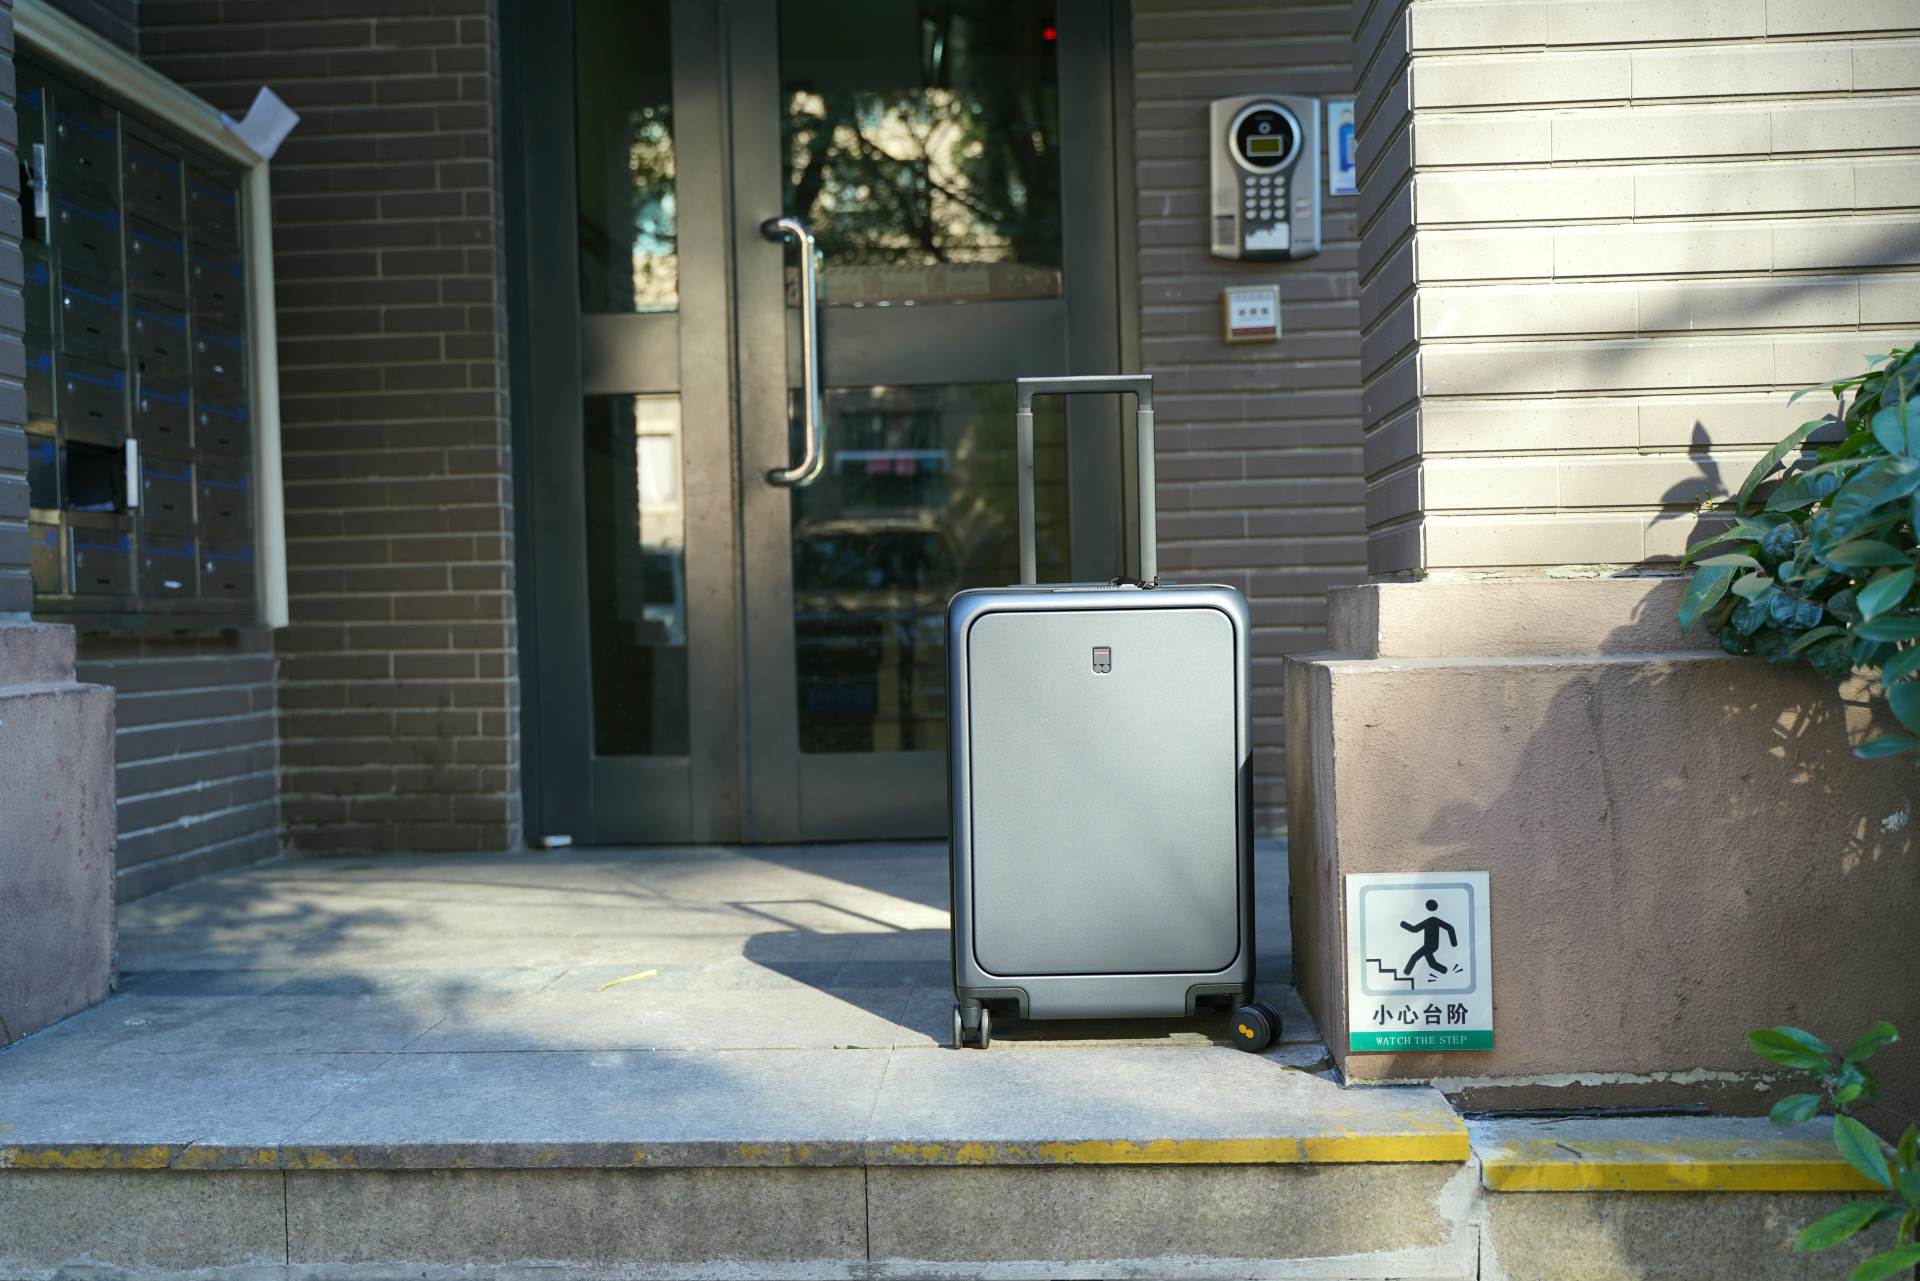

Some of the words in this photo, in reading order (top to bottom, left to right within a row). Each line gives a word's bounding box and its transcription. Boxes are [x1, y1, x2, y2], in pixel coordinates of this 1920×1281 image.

[1372, 1003, 1468, 1025] 小心台阶
[1376, 1036, 1411, 1046] WATCH
[1413, 1036, 1436, 1045] THE
[1440, 1035, 1467, 1045] STEP
